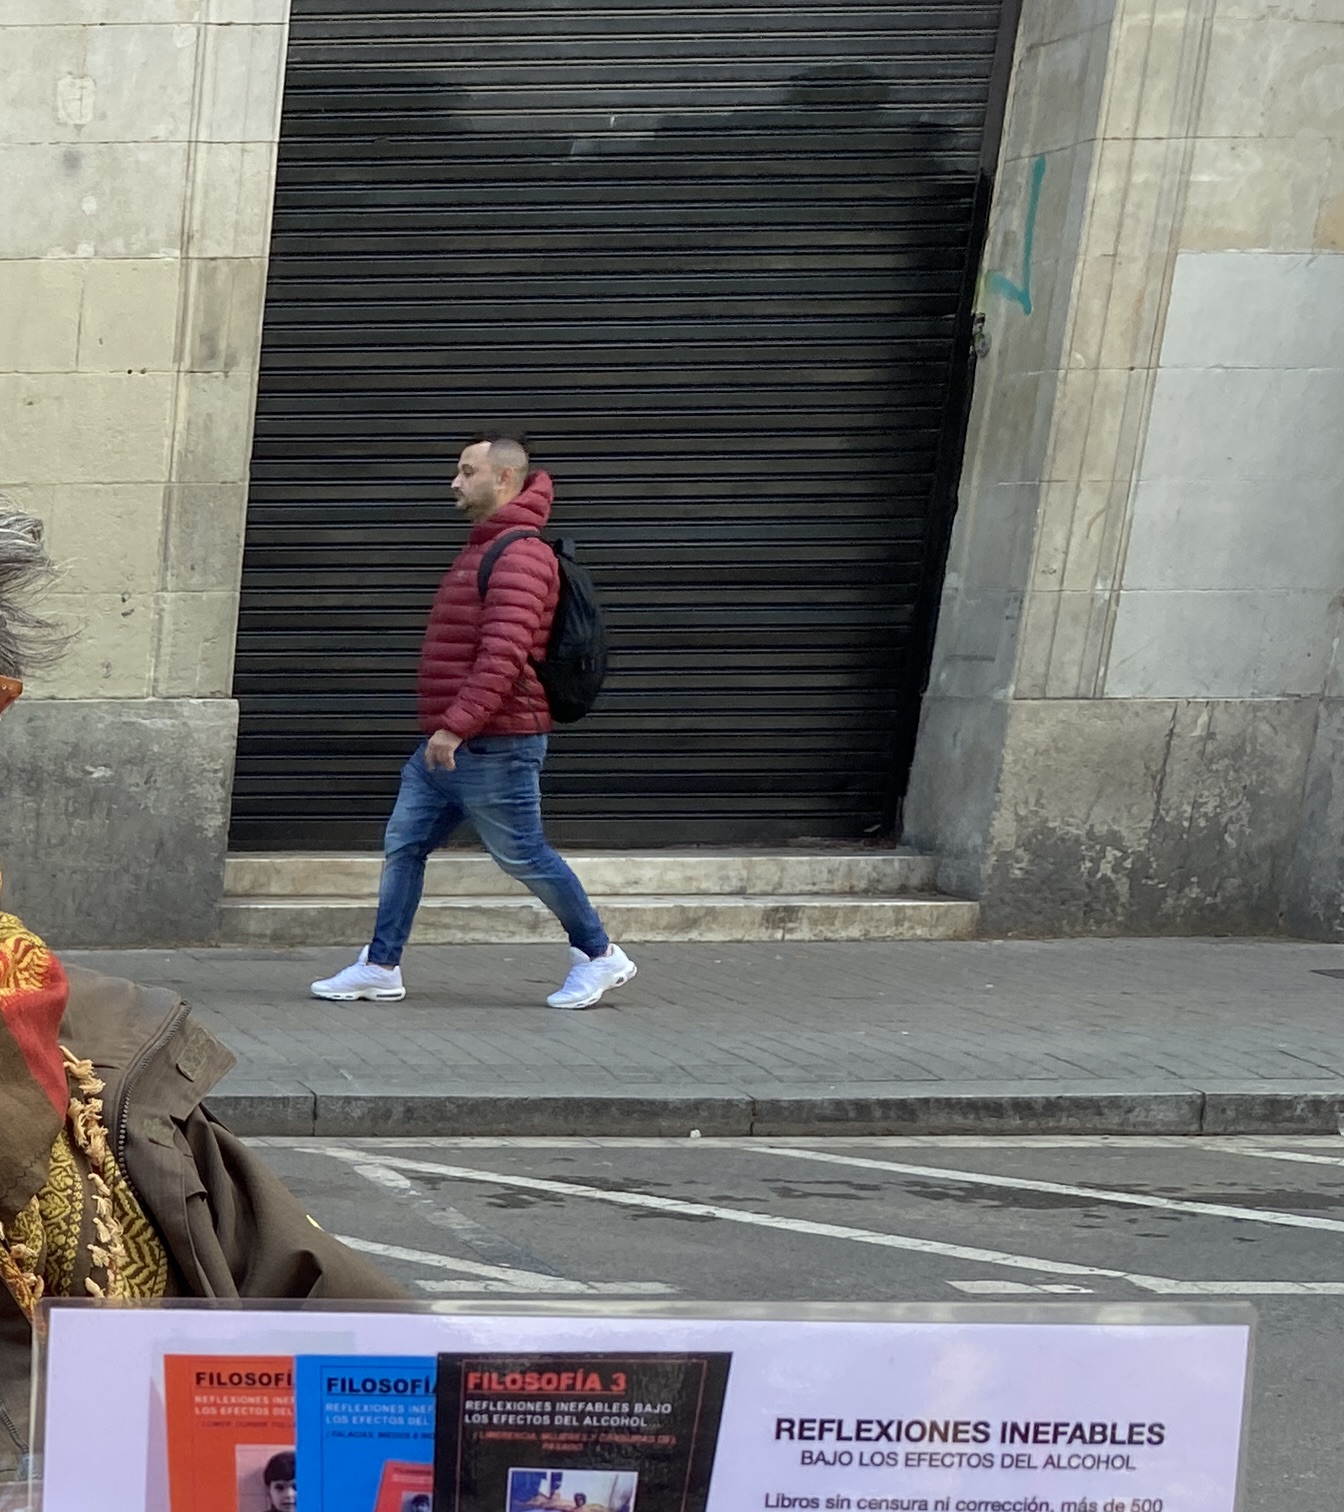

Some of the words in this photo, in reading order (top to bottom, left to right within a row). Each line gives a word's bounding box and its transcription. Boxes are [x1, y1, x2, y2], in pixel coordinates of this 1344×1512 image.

[196, 1372, 291, 1387] FILOSOFÍ
[468, 1370, 602, 1391] FILOSOFÍA
[611, 1373, 626, 1391] 3
[466, 1401, 551, 1412] REFLEXIONES
[556, 1402, 629, 1413] INEFABLES
[634, 1403, 671, 1414] BAJO
[465, 1414, 488, 1424] LOS
[493, 1414, 550, 1425] EFECTOS
[555, 1415, 578, 1425] DEL
[776, 1418, 990, 1444] REFLEXIONES
[1001, 1422, 1165, 1445] INEFABLES
[801, 1450, 853, 1466] BAJO
[859, 1451, 898, 1468] LOS
[905, 1451, 994, 1469] EFECTOS
[1001, 1453, 1037, 1470] DEL
[1043, 1453, 1136, 1470] ALCOHOL
[765, 1493, 819, 1510] Libros
[826, 1494, 851, 1510] sin
[857, 1498, 928, 1512] censura
[934, 1496, 950, 1512] ni
[1103, 1498, 1125, 1512] de
